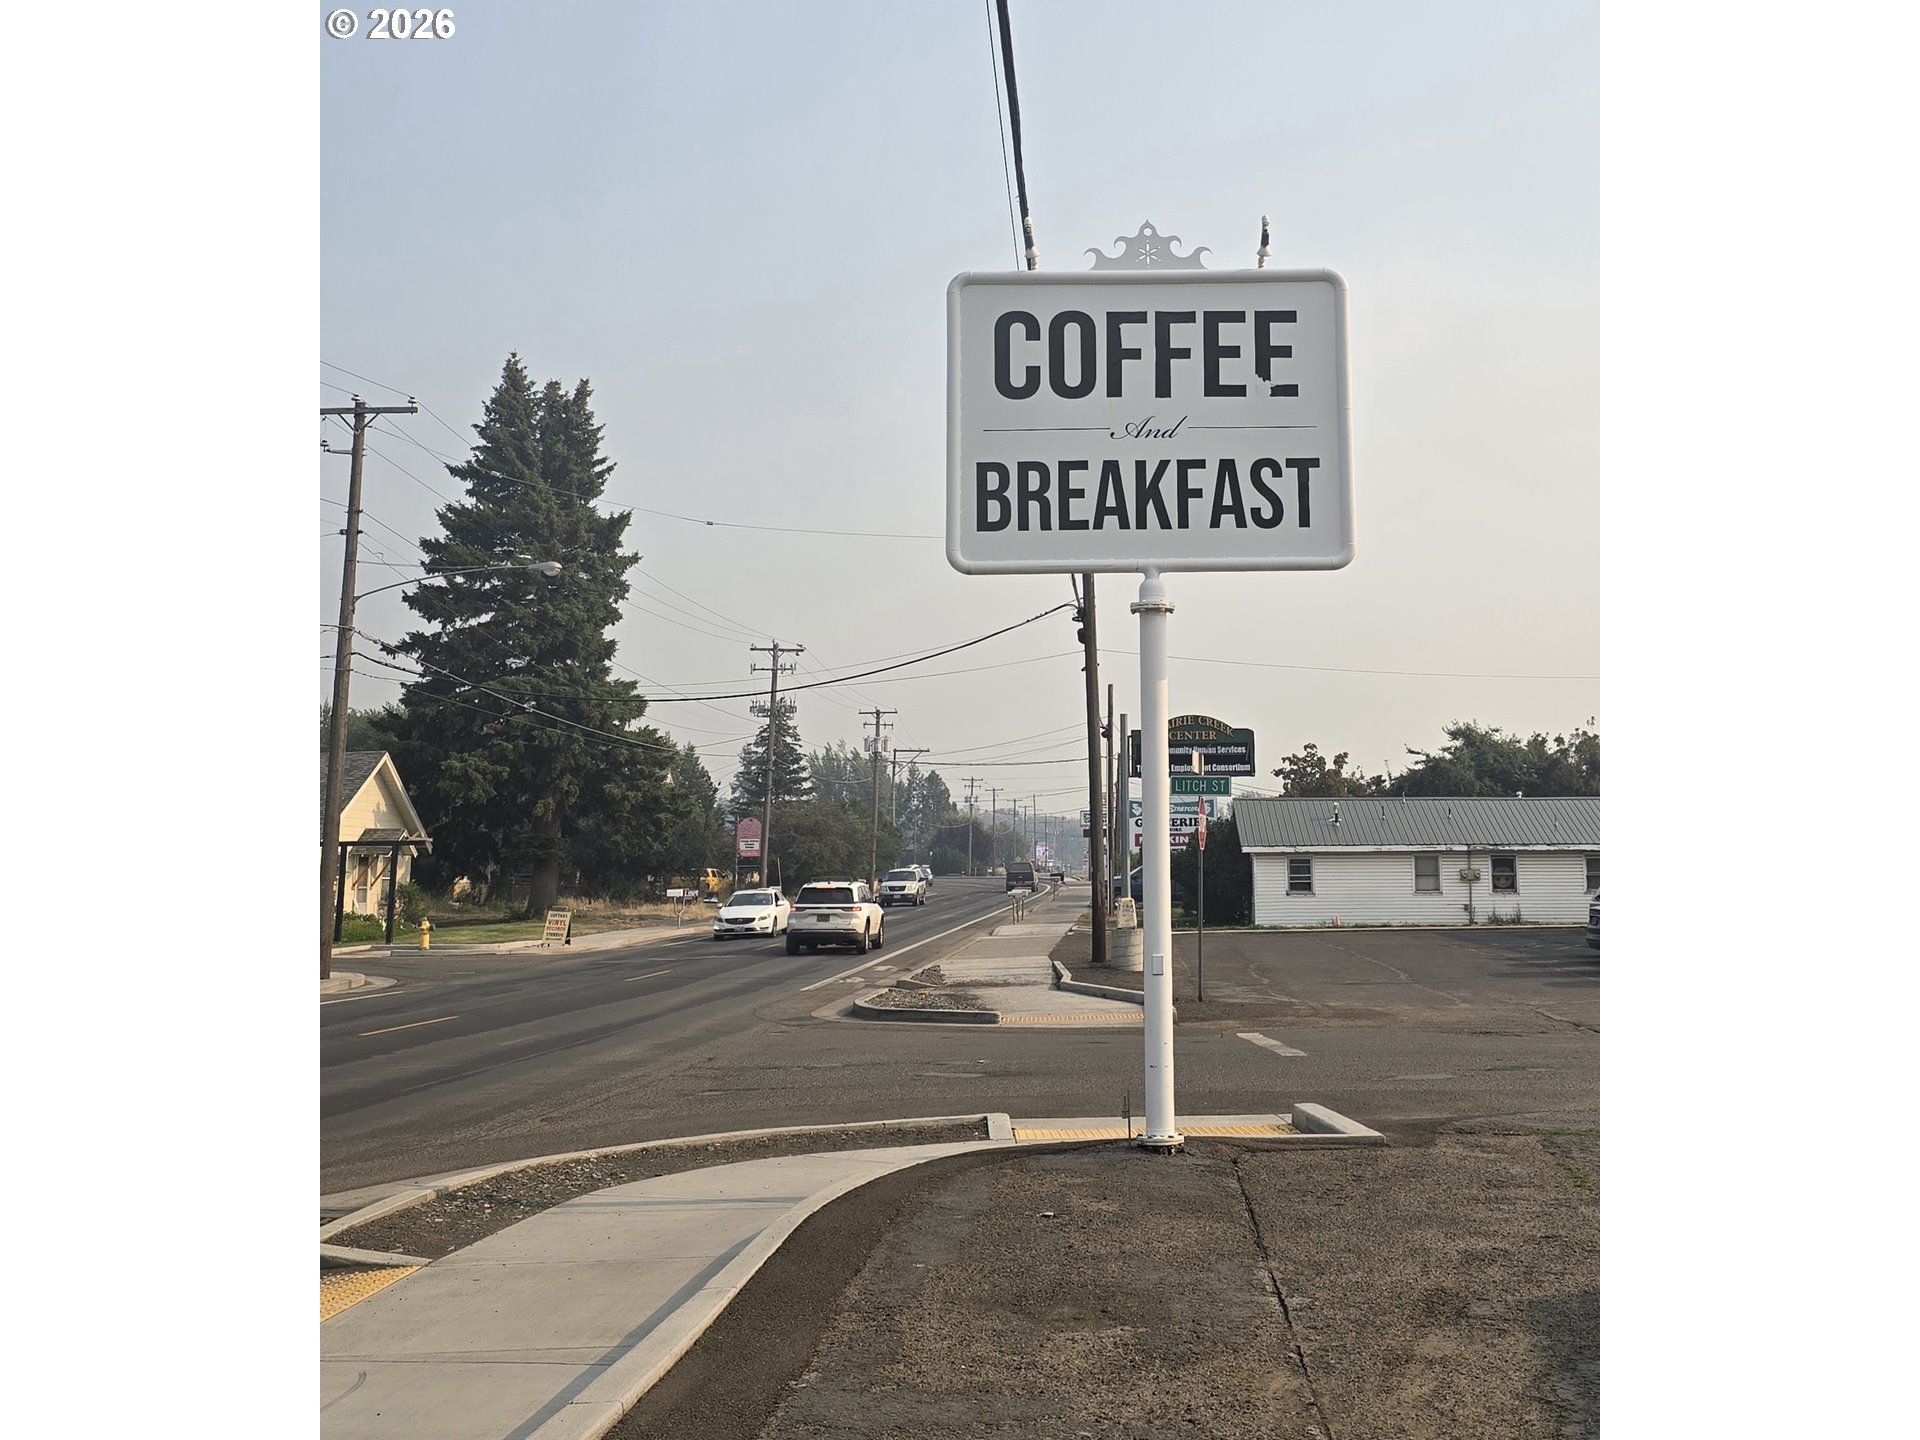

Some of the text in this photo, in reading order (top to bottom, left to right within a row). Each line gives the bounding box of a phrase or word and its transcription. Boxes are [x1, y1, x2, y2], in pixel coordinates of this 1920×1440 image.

[994, 310, 1299, 400] COFFEE
[1110, 415, 1187, 440] And
[975, 457, 1320, 532] BREAKFAST
[1169, 730, 1217, 740] CENTER
[1198, 715, 1234, 738] CREEK
[1169, 746, 1193, 755] munity
[1217, 745, 1247, 754] Services
[1212, 763, 1251, 772] Consortium
[1175, 779, 1226, 792] LITCH ST
